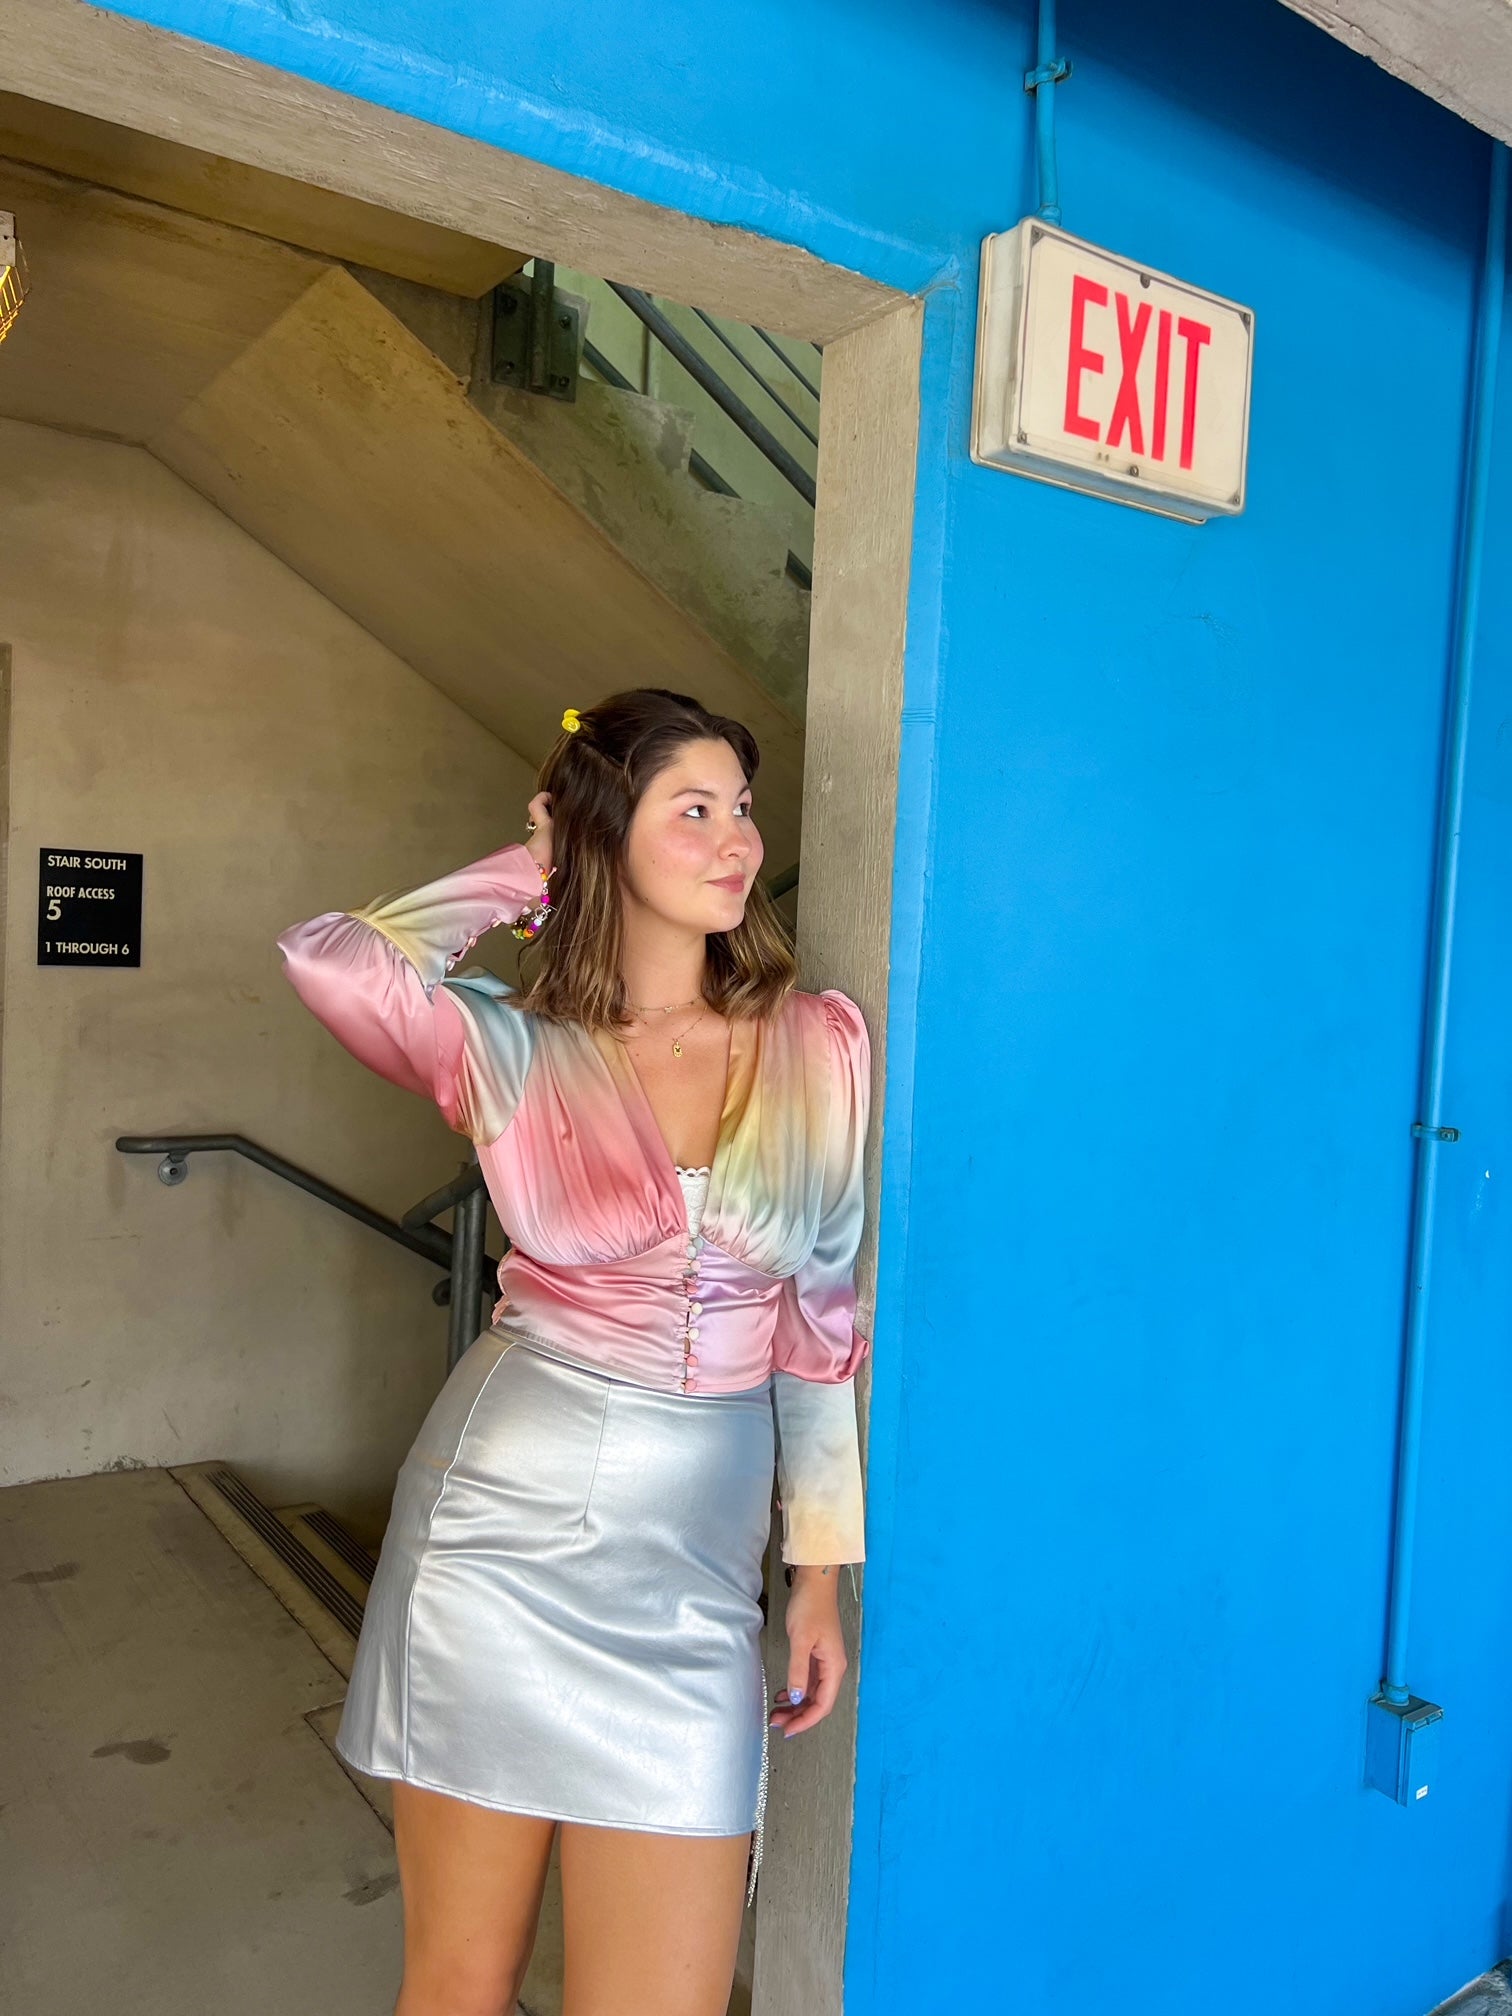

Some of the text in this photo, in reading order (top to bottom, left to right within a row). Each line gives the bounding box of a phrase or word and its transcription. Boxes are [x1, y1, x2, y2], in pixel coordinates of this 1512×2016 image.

[1063, 274, 1212, 471] EXIT
[47, 855, 127, 871] STAIR SOUTH
[46, 885, 115, 900] ROOF ACCESS
[46, 899, 62, 921] 5
[45, 941, 130, 955] 1 THROUGH 6
